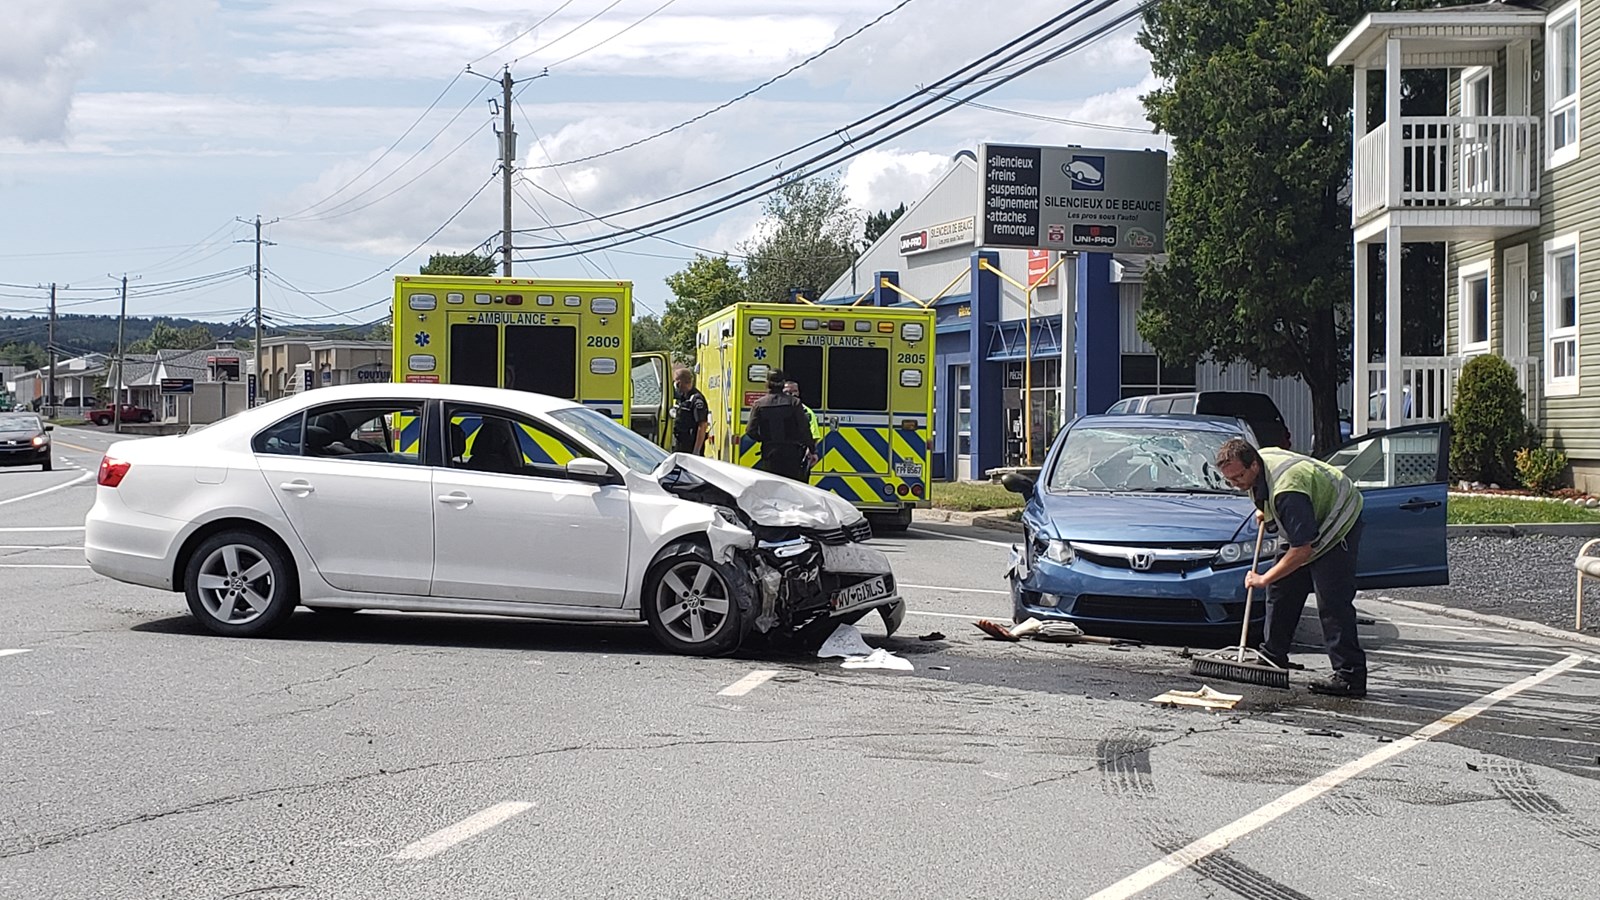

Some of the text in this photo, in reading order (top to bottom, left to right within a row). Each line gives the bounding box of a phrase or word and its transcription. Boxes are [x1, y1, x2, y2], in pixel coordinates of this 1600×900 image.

[991, 154, 1033, 169] silencieux
[991, 169, 1016, 182] freins
[990, 184, 1038, 198] suspension
[990, 197, 1038, 211] alignement
[1044, 196, 1161, 211] SILENCIEUX DE BEAUCE
[990, 211, 1027, 223] attaches
[1067, 211, 1079, 219] Les
[1081, 213, 1097, 221] pros
[993, 224, 1036, 237] remorque
[477, 312, 547, 325] AMBULANCE
[586, 336, 620, 348] 2809
[805, 335, 864, 347] AMBULANCE
[897, 353, 926, 364] 2805
